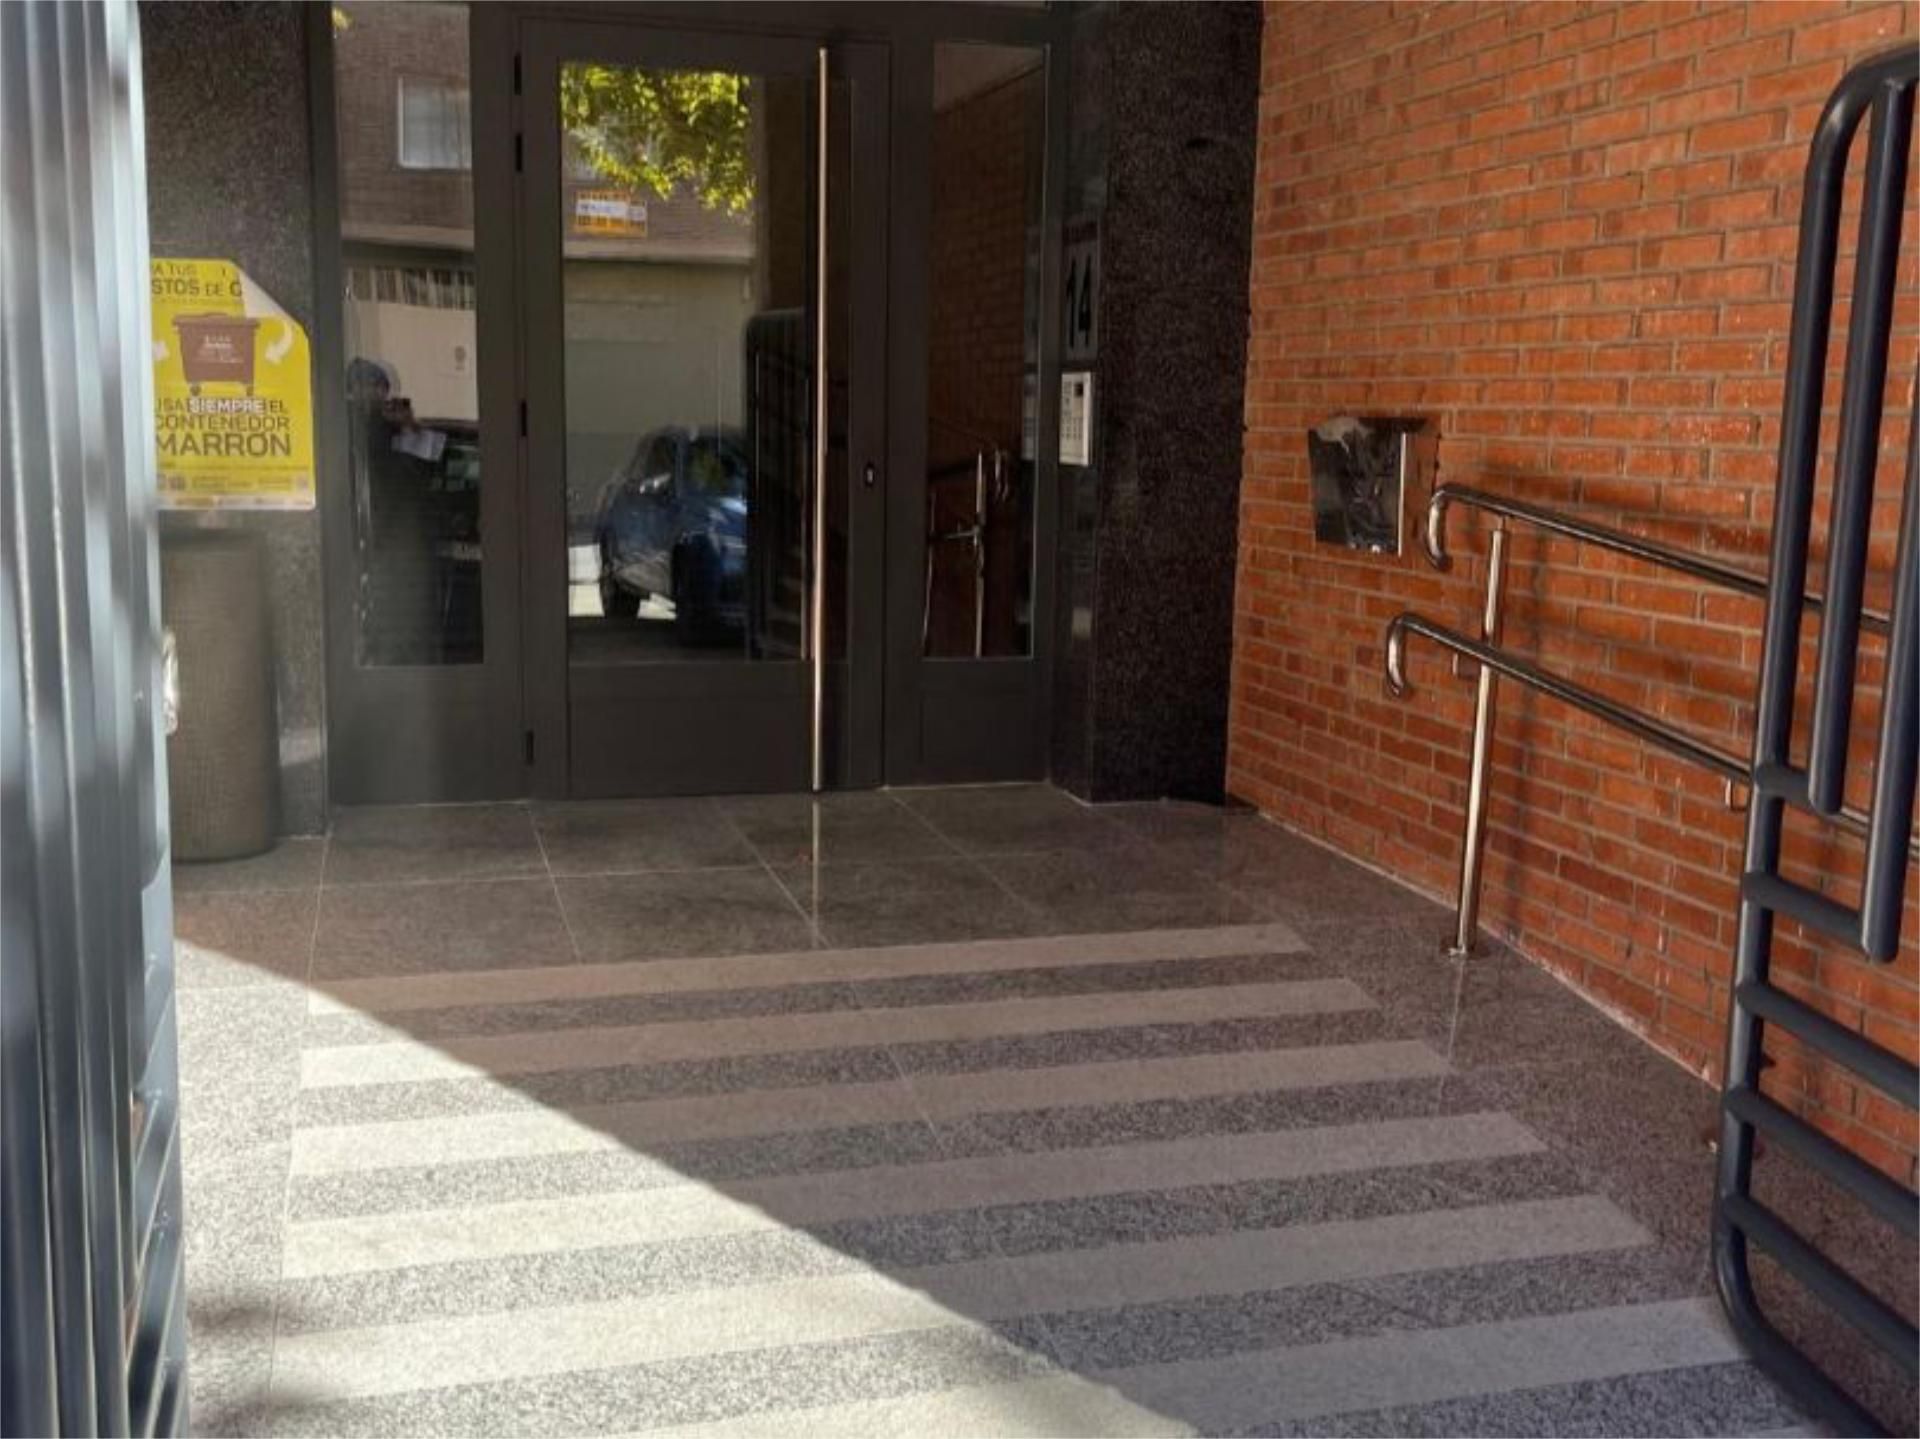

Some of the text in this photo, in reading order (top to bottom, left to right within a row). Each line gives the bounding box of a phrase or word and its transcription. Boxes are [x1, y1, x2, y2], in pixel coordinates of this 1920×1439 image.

[1066, 255, 1091, 349] 14
[188, 398, 265, 414] SIEMPRE
[269, 400, 289, 413] EL
